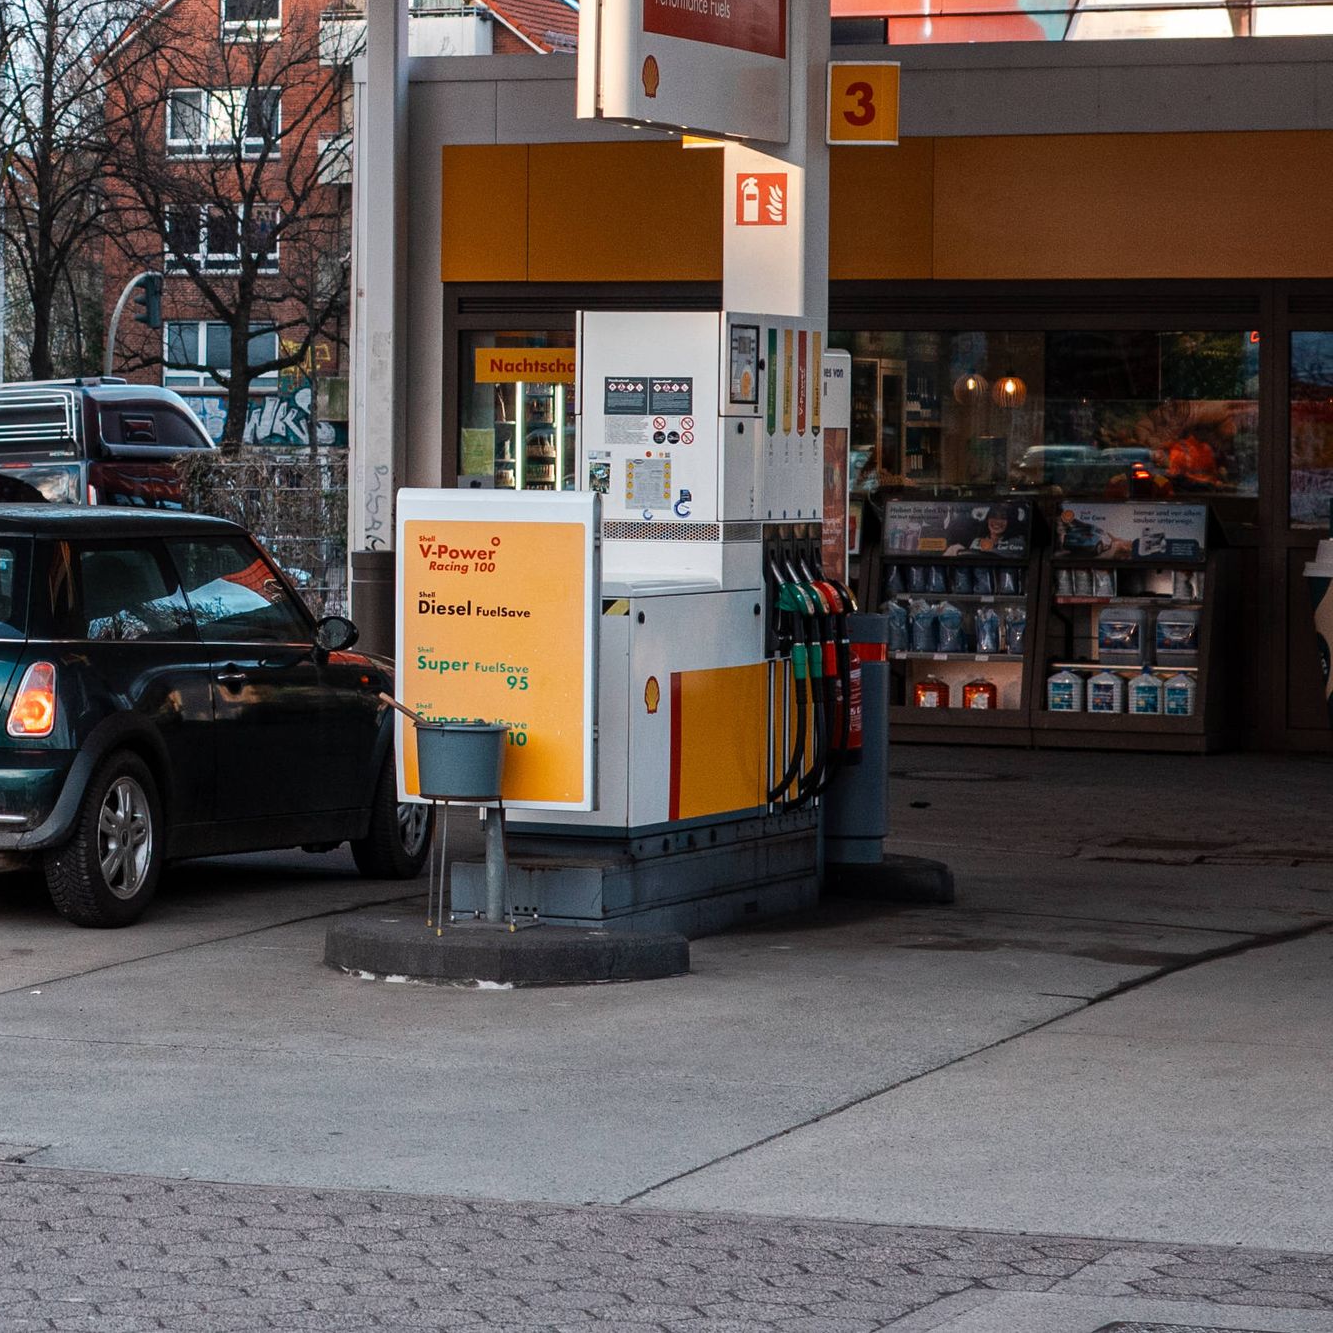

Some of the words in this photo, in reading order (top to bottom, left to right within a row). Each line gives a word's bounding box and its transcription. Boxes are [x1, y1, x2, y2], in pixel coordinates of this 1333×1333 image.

[843, 81, 876, 127] 3
[419, 543, 496, 560] V-Power
[429, 561, 469, 574] Racing
[474, 562, 495, 573] 100
[418, 599, 471, 616] Diesel
[476, 606, 531, 618] FuelSave
[417, 655, 469, 674] Super
[475, 662, 529, 674] FuelSave
[506, 675, 529, 691] 95
